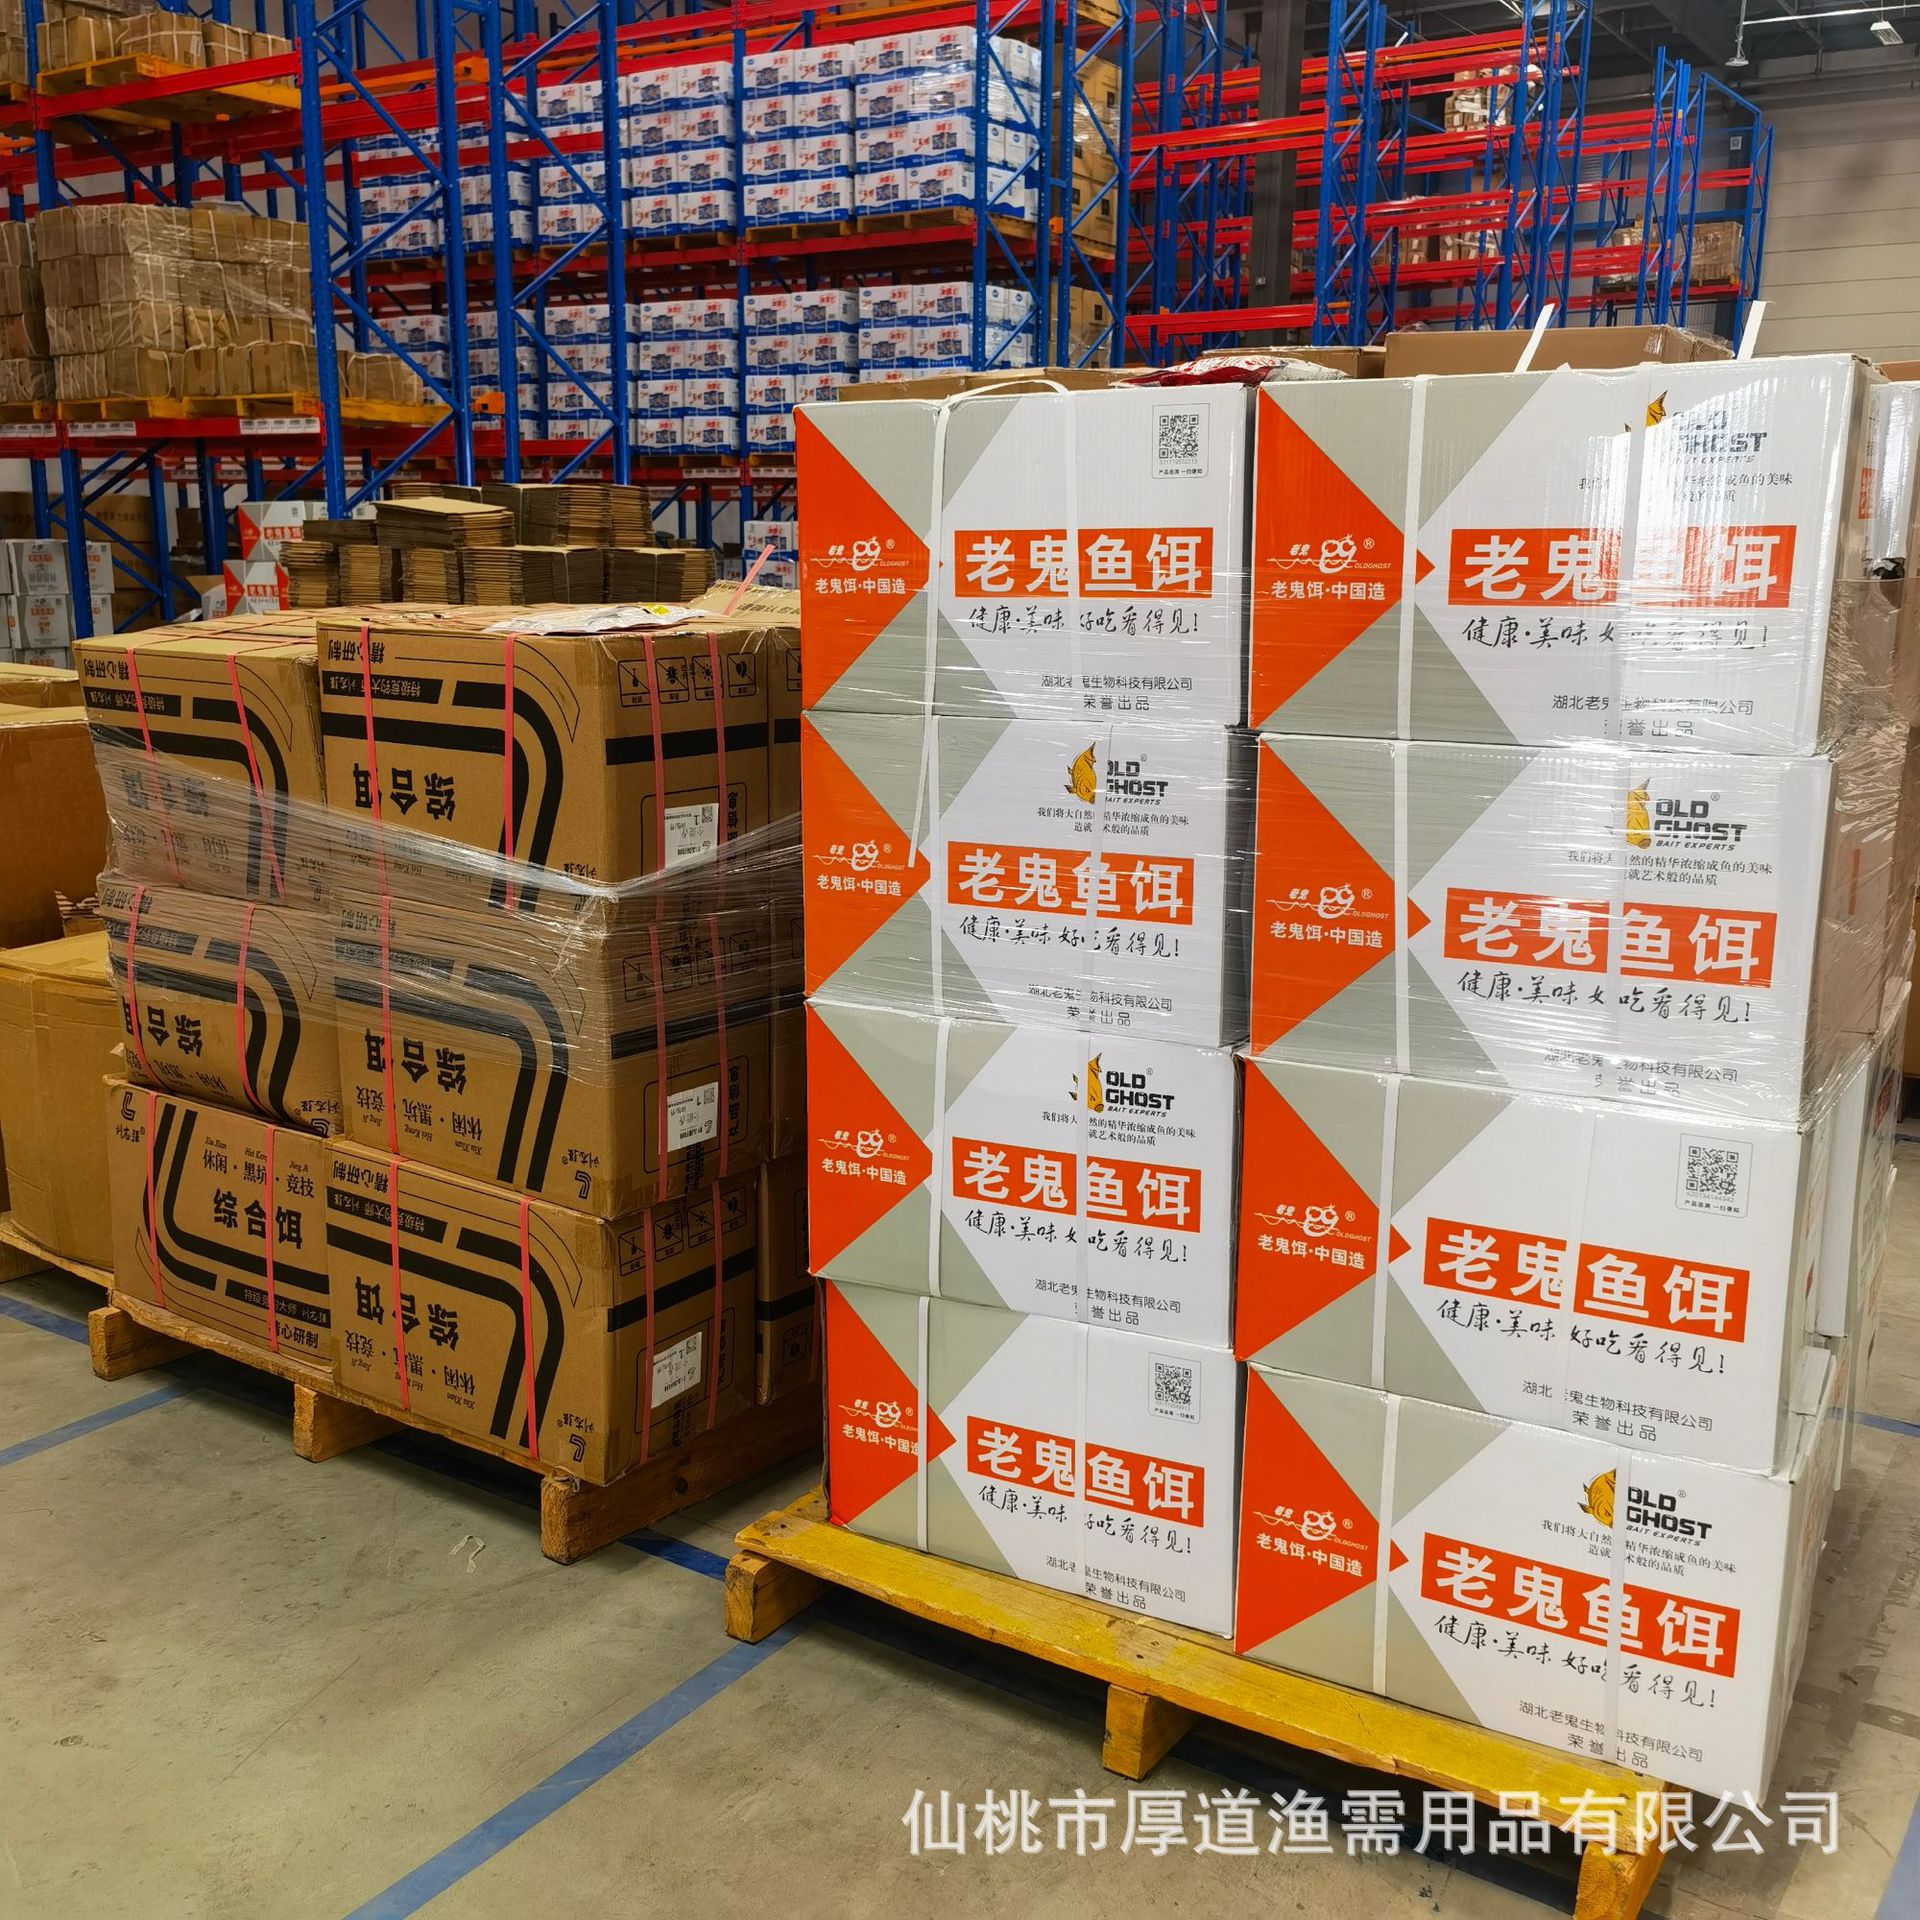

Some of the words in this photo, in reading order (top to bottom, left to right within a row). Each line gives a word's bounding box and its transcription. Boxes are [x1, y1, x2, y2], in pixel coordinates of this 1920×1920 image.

[966, 534, 1202, 593] 老鬼鱼饵
[1354, 561, 1392, 570] OLDGHOST
[1465, 533, 1780, 604] 老鬼饵
[815, 576, 906, 595] 老鬼饵·中国造
[1270, 580, 1386, 601] 老鬼饵·中国造
[1462, 617, 1588, 649] 健康·美味
[1083, 694, 1150, 711] 荣誉出品
[1604, 719, 1694, 737] 誉出品
[1123, 797, 1161, 805] EXPERTS
[1655, 798, 1710, 819] OLD
[1074, 822, 1150, 837] 造就术般的品质
[1654, 818, 1748, 843] GHOST
[1655, 841, 1680, 849] BAIT
[1683, 842, 1735, 852] EXPERTS
[817, 874, 902, 897] 老鬼饵·中国造
[958, 849, 1184, 919] 老鬼鱼饵
[1624, 870, 1718, 887] 就艺术般的品质
[1352, 909, 1389, 920] OLDGHOST
[1270, 920, 1383, 949] 老鬼饵·中国造
[1459, 896, 1763, 981] 老鬼鱼饵
[1457, 970, 1578, 1006] 健康·美味
[1106, 1070, 1146, 1089] OLD
[1105, 1089, 1175, 1111] GHOST
[1108, 1105, 1127, 1114] BAIT
[1129, 1107, 1168, 1118] EXPERTS
[1042, 1111, 1196, 1139] 我们将大然的精华浓缩成鱼的美味
[333, 1160, 389, 1194] 精心研制
[822, 1158, 907, 1185] 老鬼饵·中国造
[963, 1146, 1191, 1225] 老鬼鱼饵
[213, 1187, 303, 1249] 综合饵
[965, 1209, 1057, 1243] 健康·美味
[1335, 1229, 1372, 1242] OLDGHOST
[1258, 1233, 1365, 1270] 老鬼饵·中国造
[1439, 1230, 1735, 1332] 老鬼鱼饵
[354, 1275, 459, 1352] 综合饵
[1074, 1301, 1140, 1326] 誉出品
[1439, 1299, 1556, 1341] 健康·美味
[1522, 1380, 1713, 1431] 湖北鬼生物科技有限公司
[1572, 1410, 1657, 1442] 荣誉出品
[977, 1428, 1194, 1519] 老鬼鱼饵
[978, 1484, 1067, 1523] 健康·美味
[1626, 1486, 1677, 1513] OLD
[1625, 1508, 1713, 1540] GHOST
[1626, 1524, 1652, 1536] BAIT
[1654, 1529, 1702, 1547] EXPERTS
[1256, 1532, 1363, 1577] 老鬼饵·中国造
[1333, 1535, 1369, 1550] OLDGHOST
[1542, 1520, 1737, 1574] 我们将大自然精华浓缩成鱼的美味
[1587, 1543, 1685, 1577] 造就术般的品质
[1085, 1581, 1147, 1610] 荣誉出品
[1436, 1548, 1727, 1667] 老鬼鱼饵
[1434, 1615, 1551, 1665] 健康·美味
